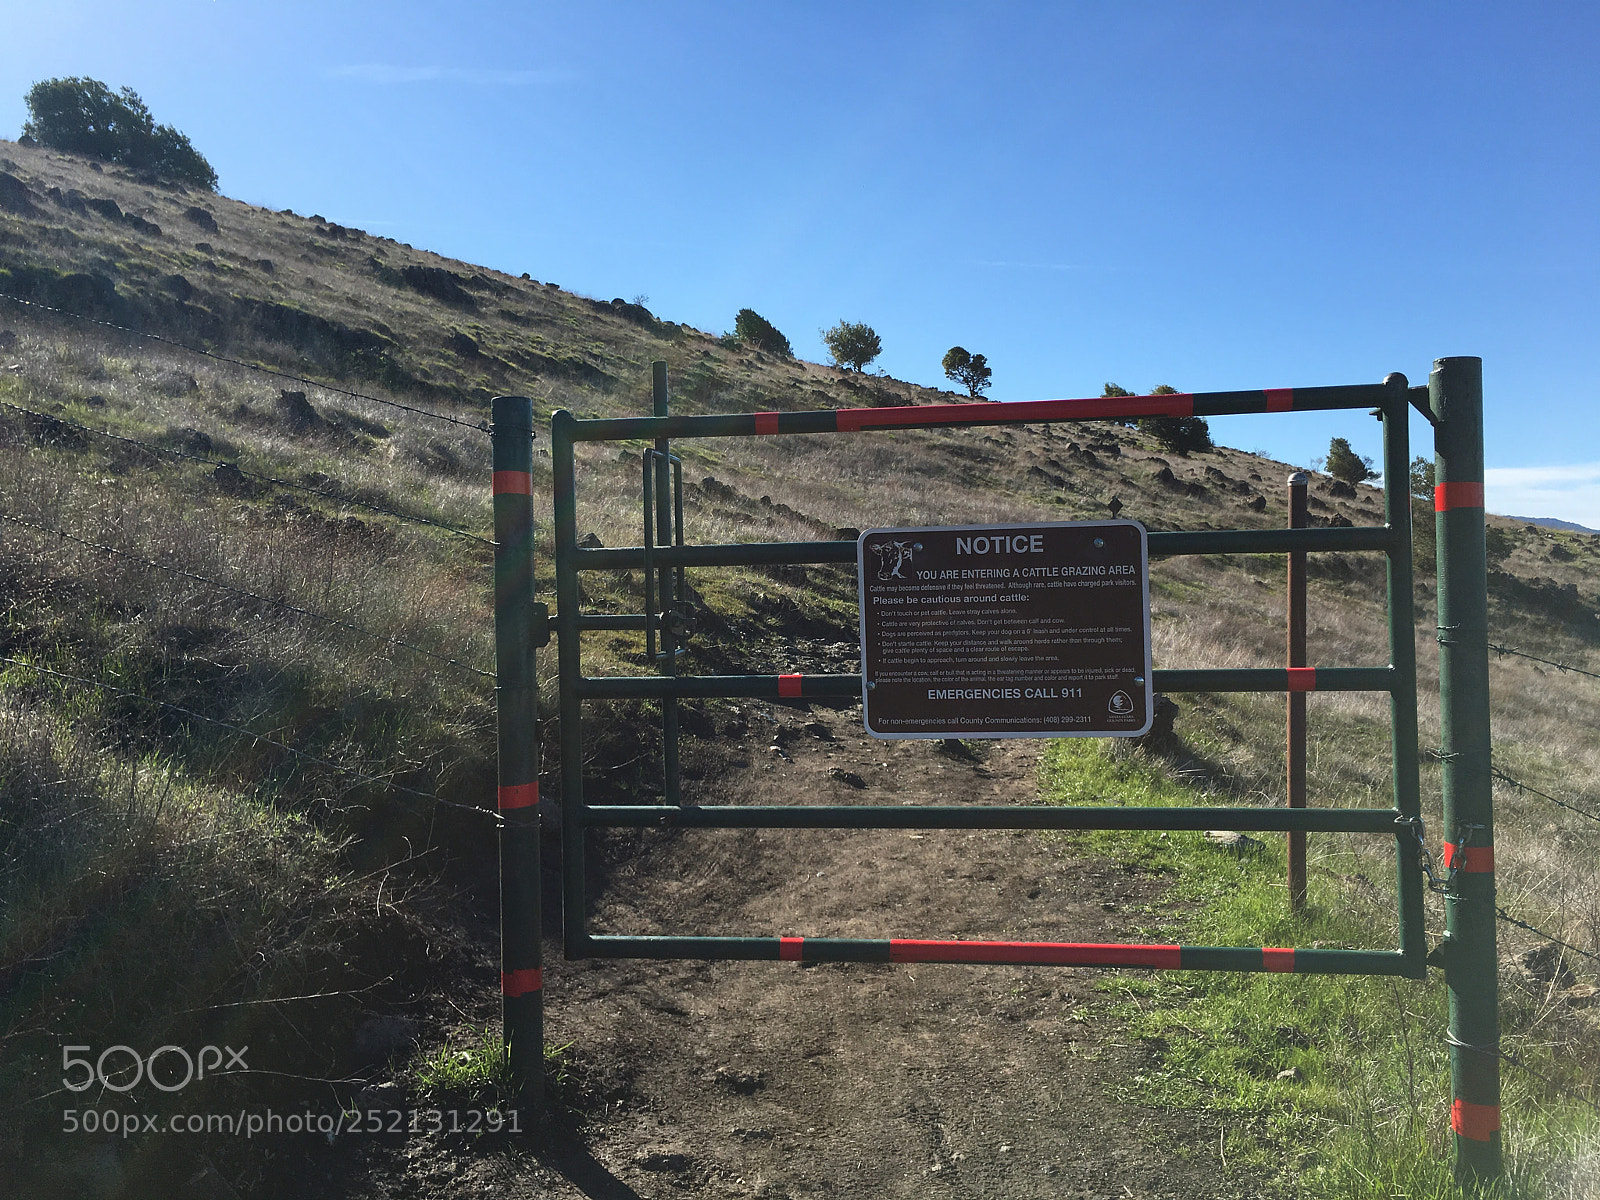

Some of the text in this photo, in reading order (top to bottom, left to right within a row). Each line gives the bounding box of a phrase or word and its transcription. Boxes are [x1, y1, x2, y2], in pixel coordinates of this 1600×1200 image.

[956, 534, 1043, 555] NOTICE
[916, 564, 1135, 580] YOU ARE ENTERING A CATTLE GRAZING AREA
[951, 583, 962, 591] they
[1007, 581, 1032, 589] Although
[1077, 579, 1100, 587] charged
[1101, 578, 1113, 587] park
[873, 592, 1029, 604] Please be cautious around cattle:
[928, 687, 1081, 699] EMERGENCIES CALL 911
[890, 717, 945, 725] non-emergencies
[959, 716, 983, 724] County
[984, 715, 1042, 723] Communications:
[1043, 715, 1059, 723] (408)
